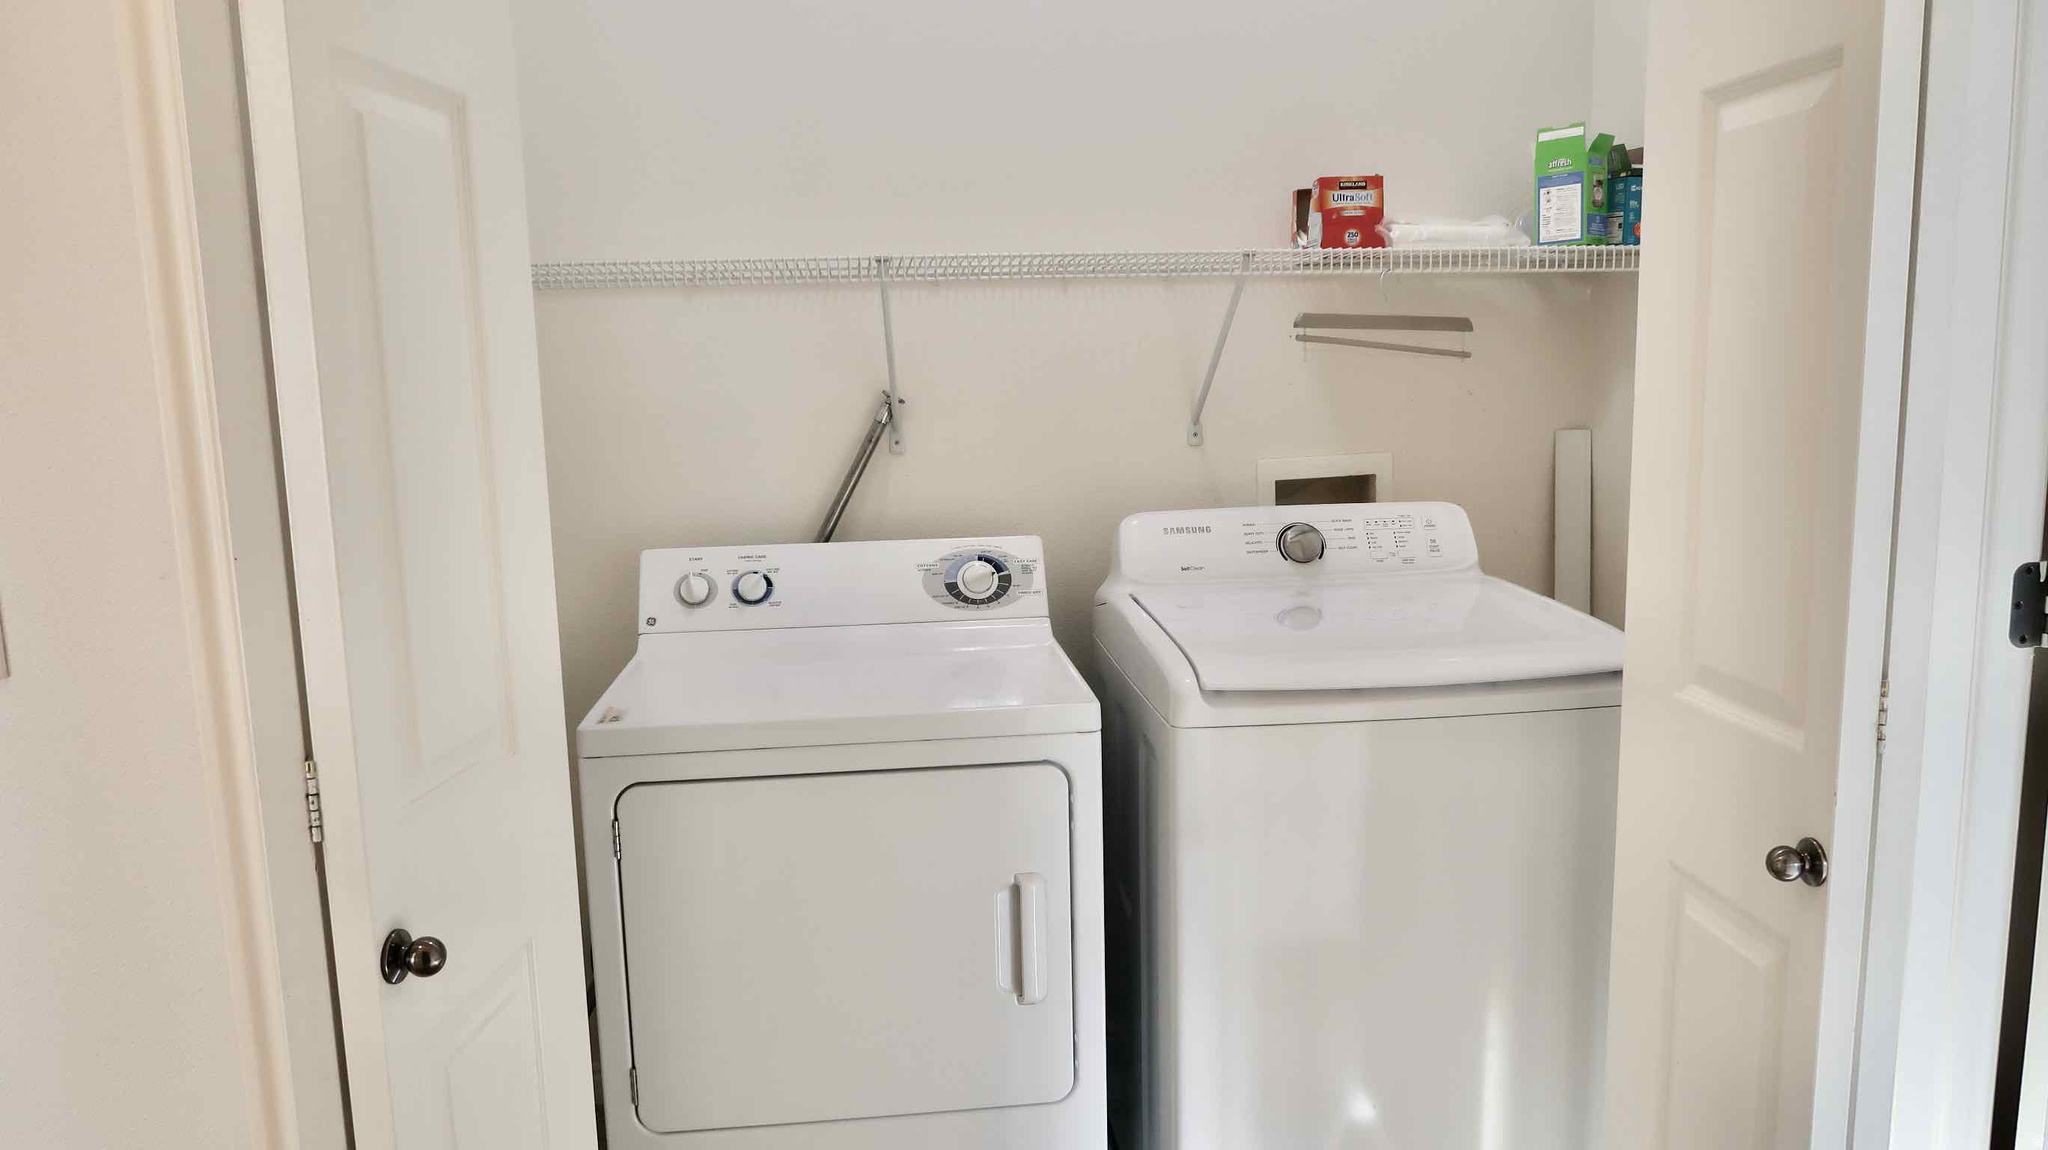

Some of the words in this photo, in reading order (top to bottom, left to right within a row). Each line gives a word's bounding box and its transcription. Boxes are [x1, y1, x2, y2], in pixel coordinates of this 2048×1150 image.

[1547, 156, 1572, 169] affresh
[1332, 191, 1373, 202] UltraSoft
[1163, 525, 1212, 535] SAMSUNG
